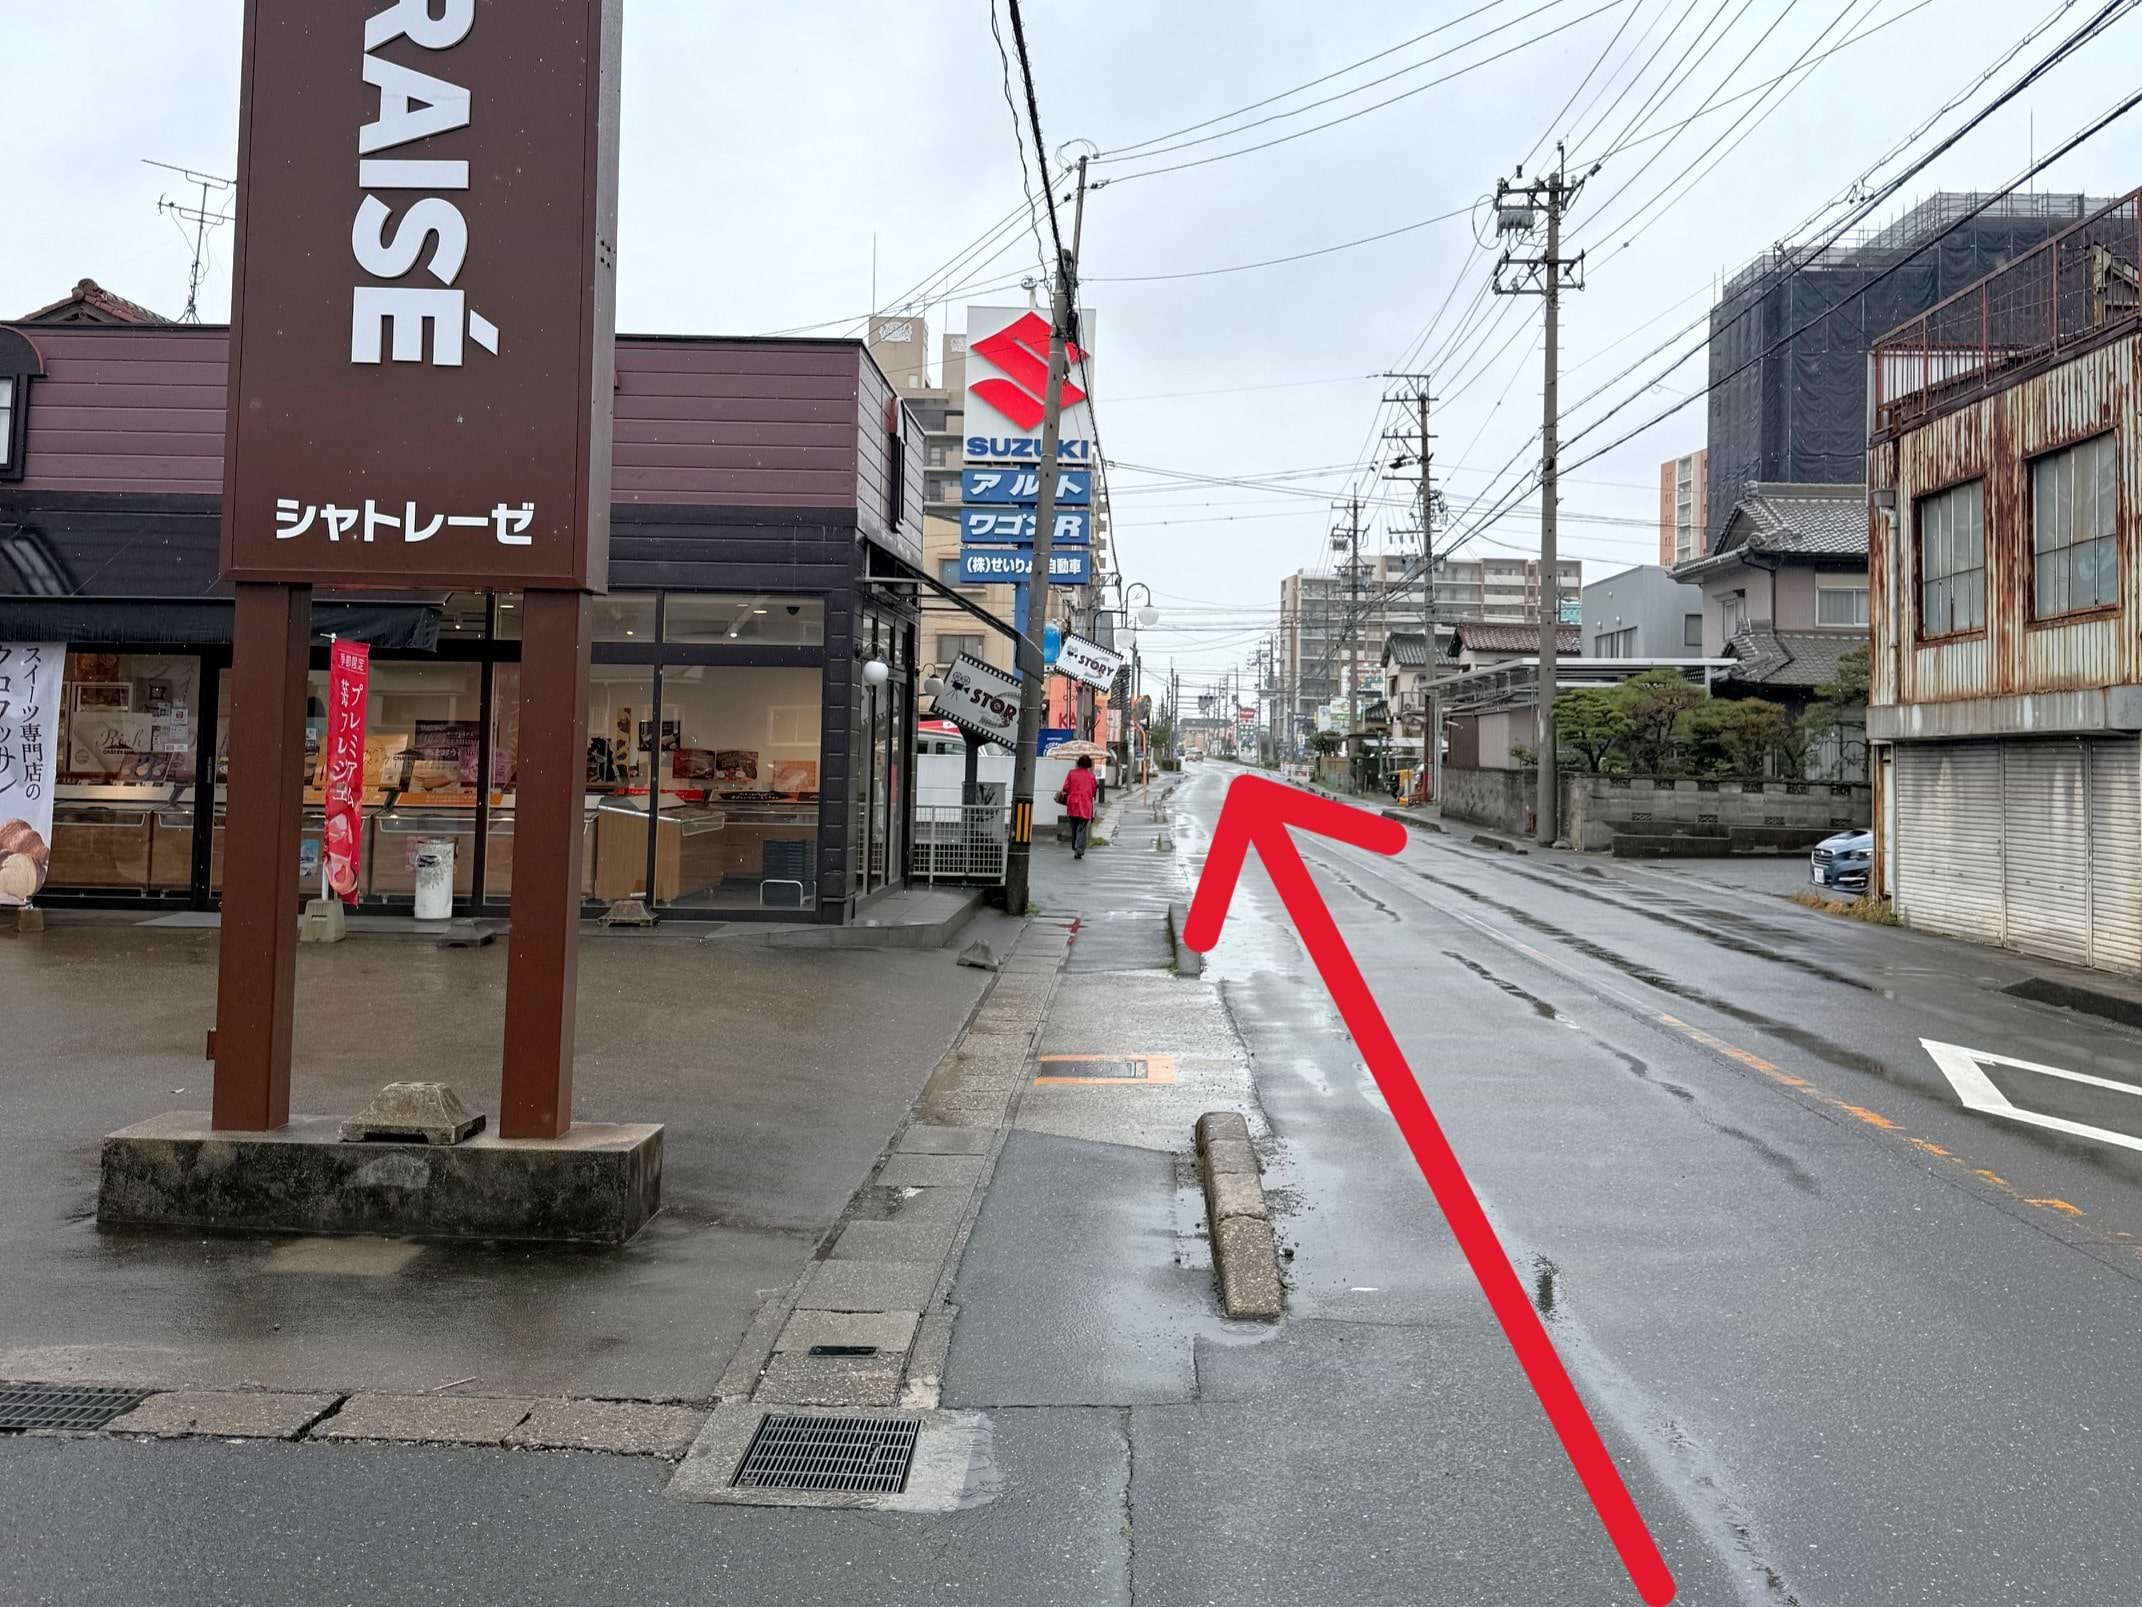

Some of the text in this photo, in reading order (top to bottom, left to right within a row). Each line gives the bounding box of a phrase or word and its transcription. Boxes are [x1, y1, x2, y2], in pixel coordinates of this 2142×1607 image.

[276, 499, 534, 545] シャトレーゼ
[967, 556, 1081, 574] (株)せいりょ自動車
[1078, 655, 1114, 676] STORY
[970, 689, 1020, 721] STOR
[20, 647, 44, 801] スイーツ専門店の
